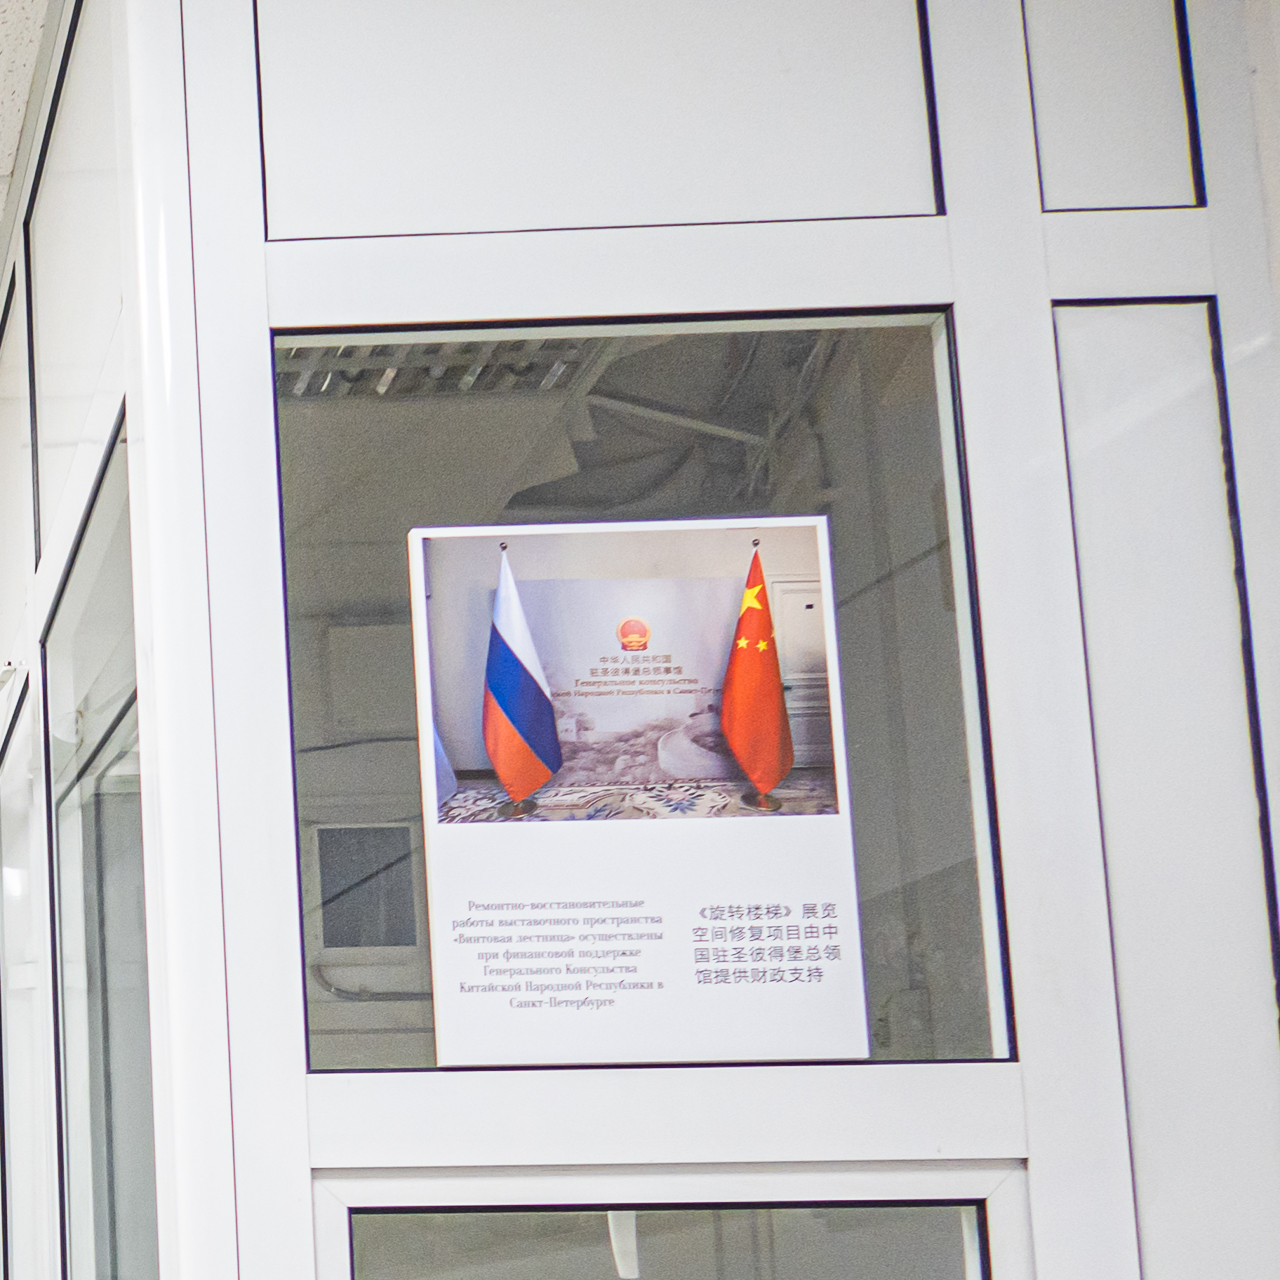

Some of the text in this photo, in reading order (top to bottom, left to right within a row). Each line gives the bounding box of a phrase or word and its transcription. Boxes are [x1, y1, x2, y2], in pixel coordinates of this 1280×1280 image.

[468, 899, 645, 911] Ремонтно-восстановительные
[452, 916, 663, 931] работы выставочного пространства
[453, 932, 664, 945] «Винтовая лестница» осуществлены
[692, 923, 838, 942] 空间修复项目由中
[477, 949, 641, 964] при финансовой поддержке
[694, 944, 842, 963] 国驻圣彼得堡总领
[483, 964, 638, 978] Генерального Консульства
[694, 966, 823, 984] 馆提供财政支持
[459, 981, 521, 993] Китайской
[525, 980, 582, 994] Народной
[585, 979, 653, 993] Республики
[509, 996, 615, 1010] Санкт-Петербурге
